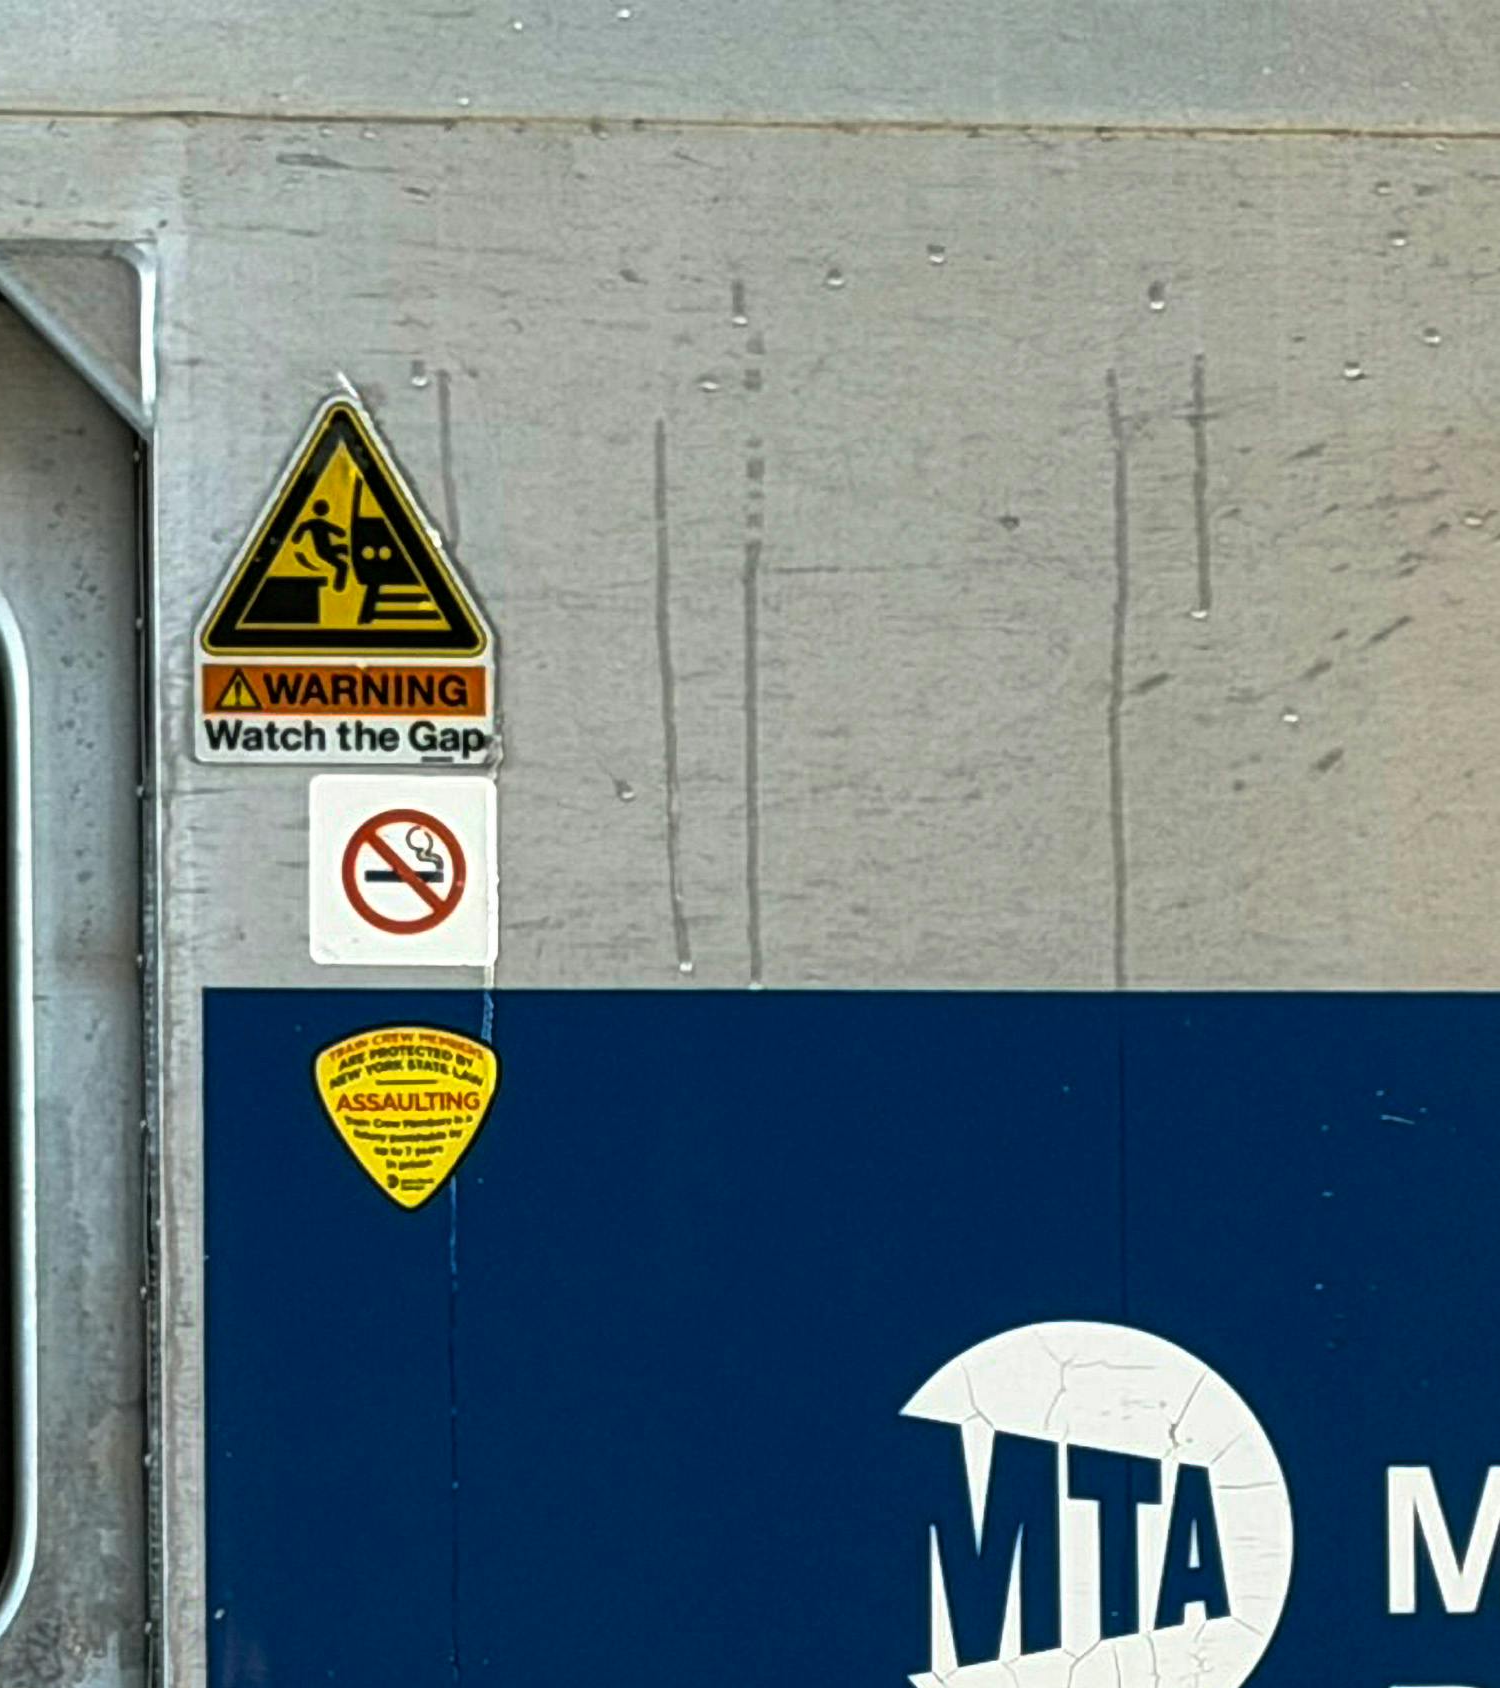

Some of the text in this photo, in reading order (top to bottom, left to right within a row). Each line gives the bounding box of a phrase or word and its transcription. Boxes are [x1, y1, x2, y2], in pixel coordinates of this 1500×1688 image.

[263, 672, 469, 707] WARNING
[204, 719, 486, 759] Watch the Gap
[336, 1091, 481, 1112] ASSAULTING
[928, 1417, 1234, 1678] MTA
